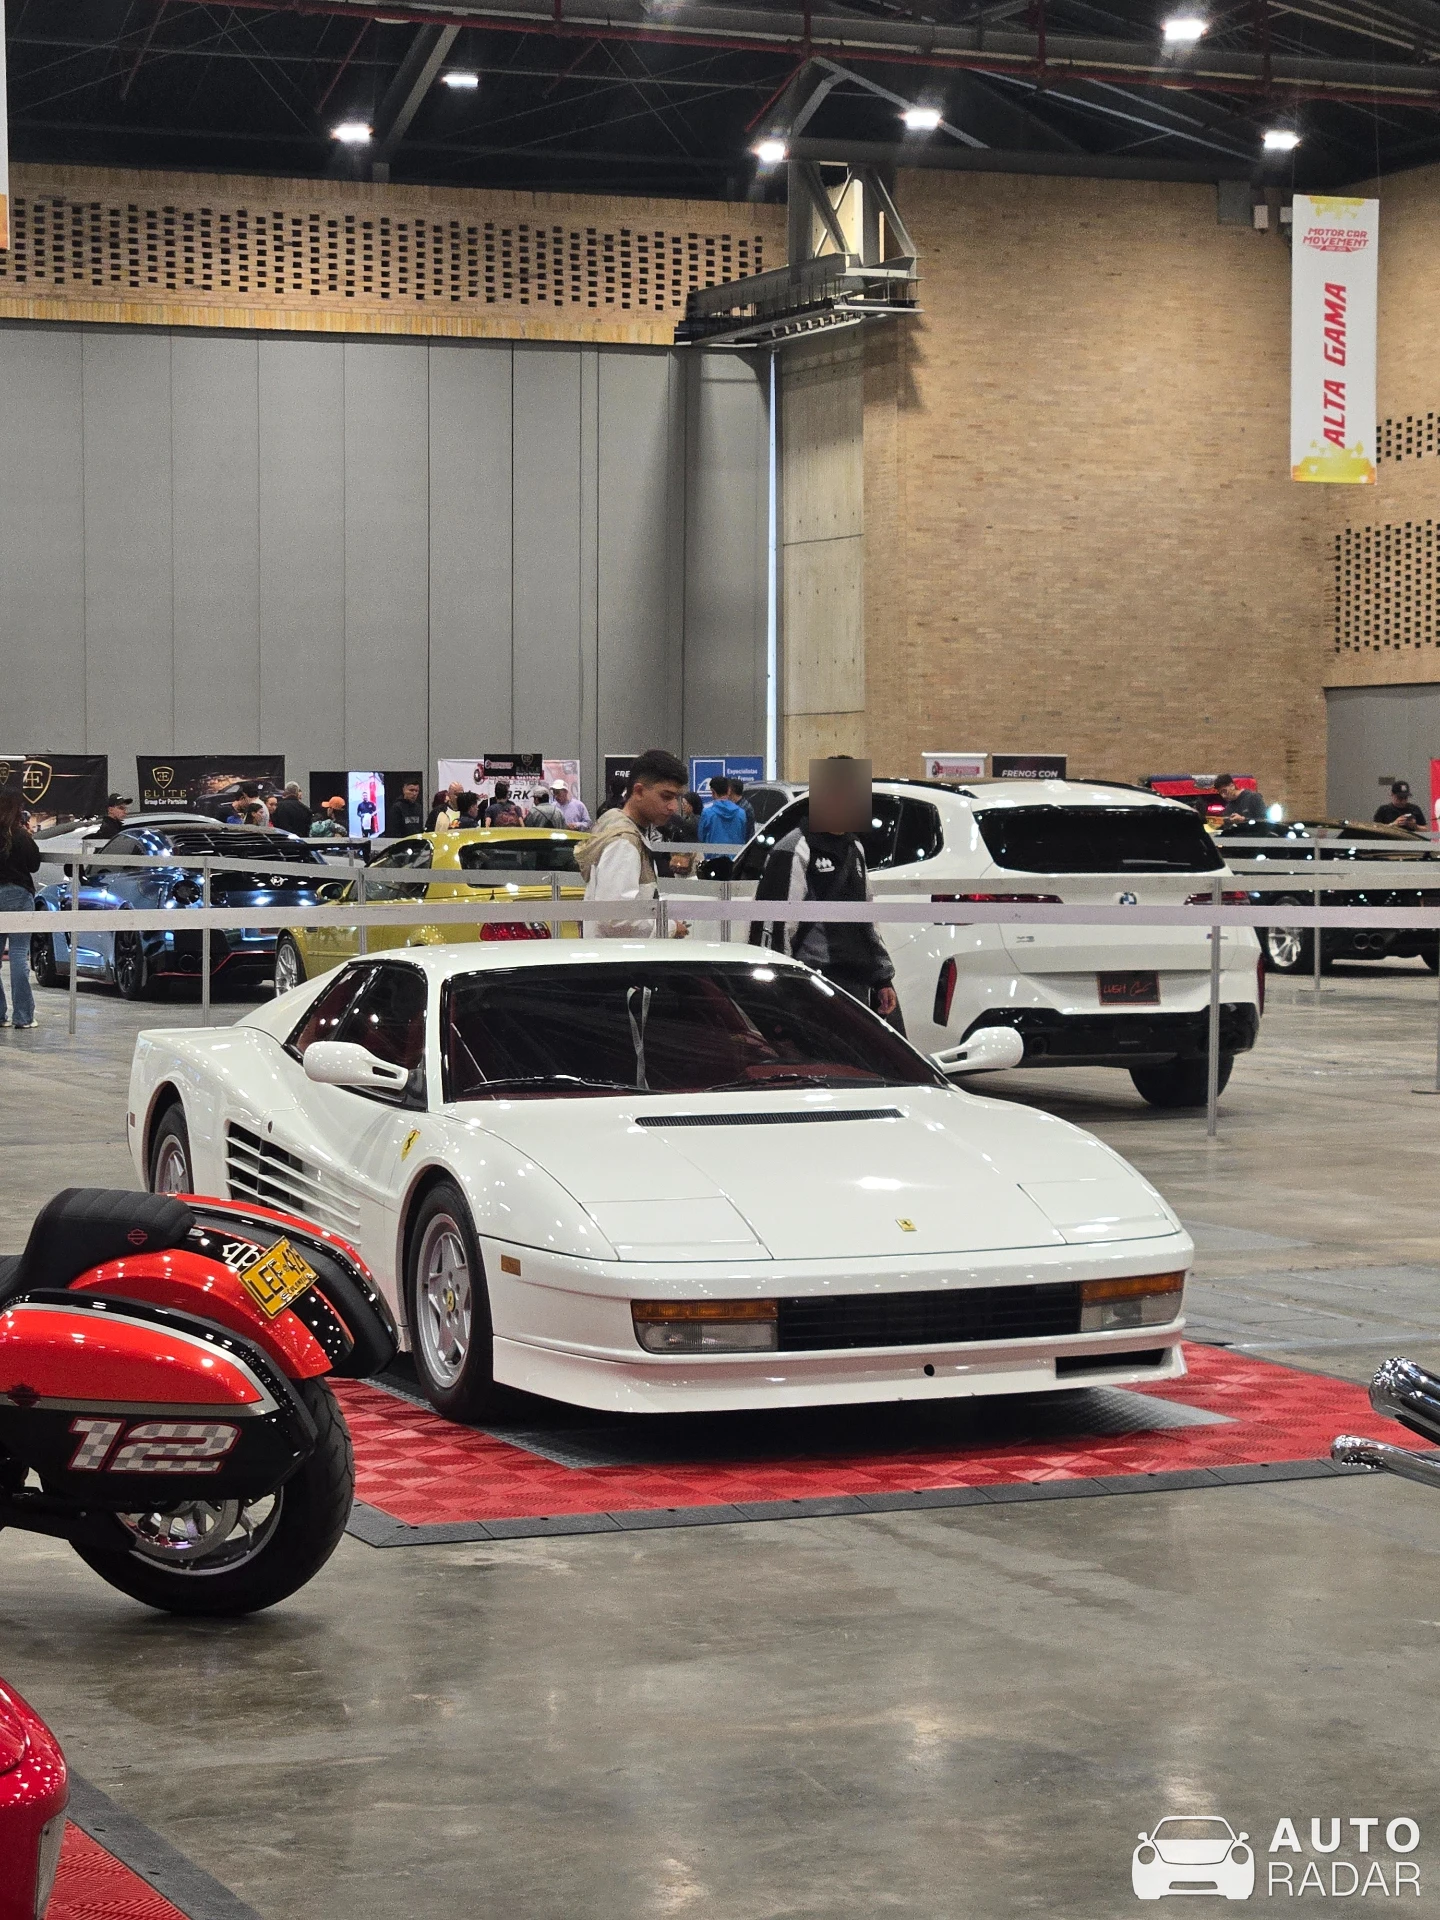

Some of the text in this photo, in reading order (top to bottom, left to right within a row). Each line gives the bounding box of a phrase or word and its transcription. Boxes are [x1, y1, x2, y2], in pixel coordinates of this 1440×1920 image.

[1308, 228, 1368, 239] MOTOR CAR
[1302, 236, 1369, 247] MOVEMENT
[1323, 282, 1347, 449] ALTA GAMA
[1002, 769, 1058, 778] FRENOS CON
[144, 789, 187, 797] ELITE
[144, 798, 158, 806] Group
[247, 1257, 288, 1304] LEF
[68, 1417, 242, 1474] 12
